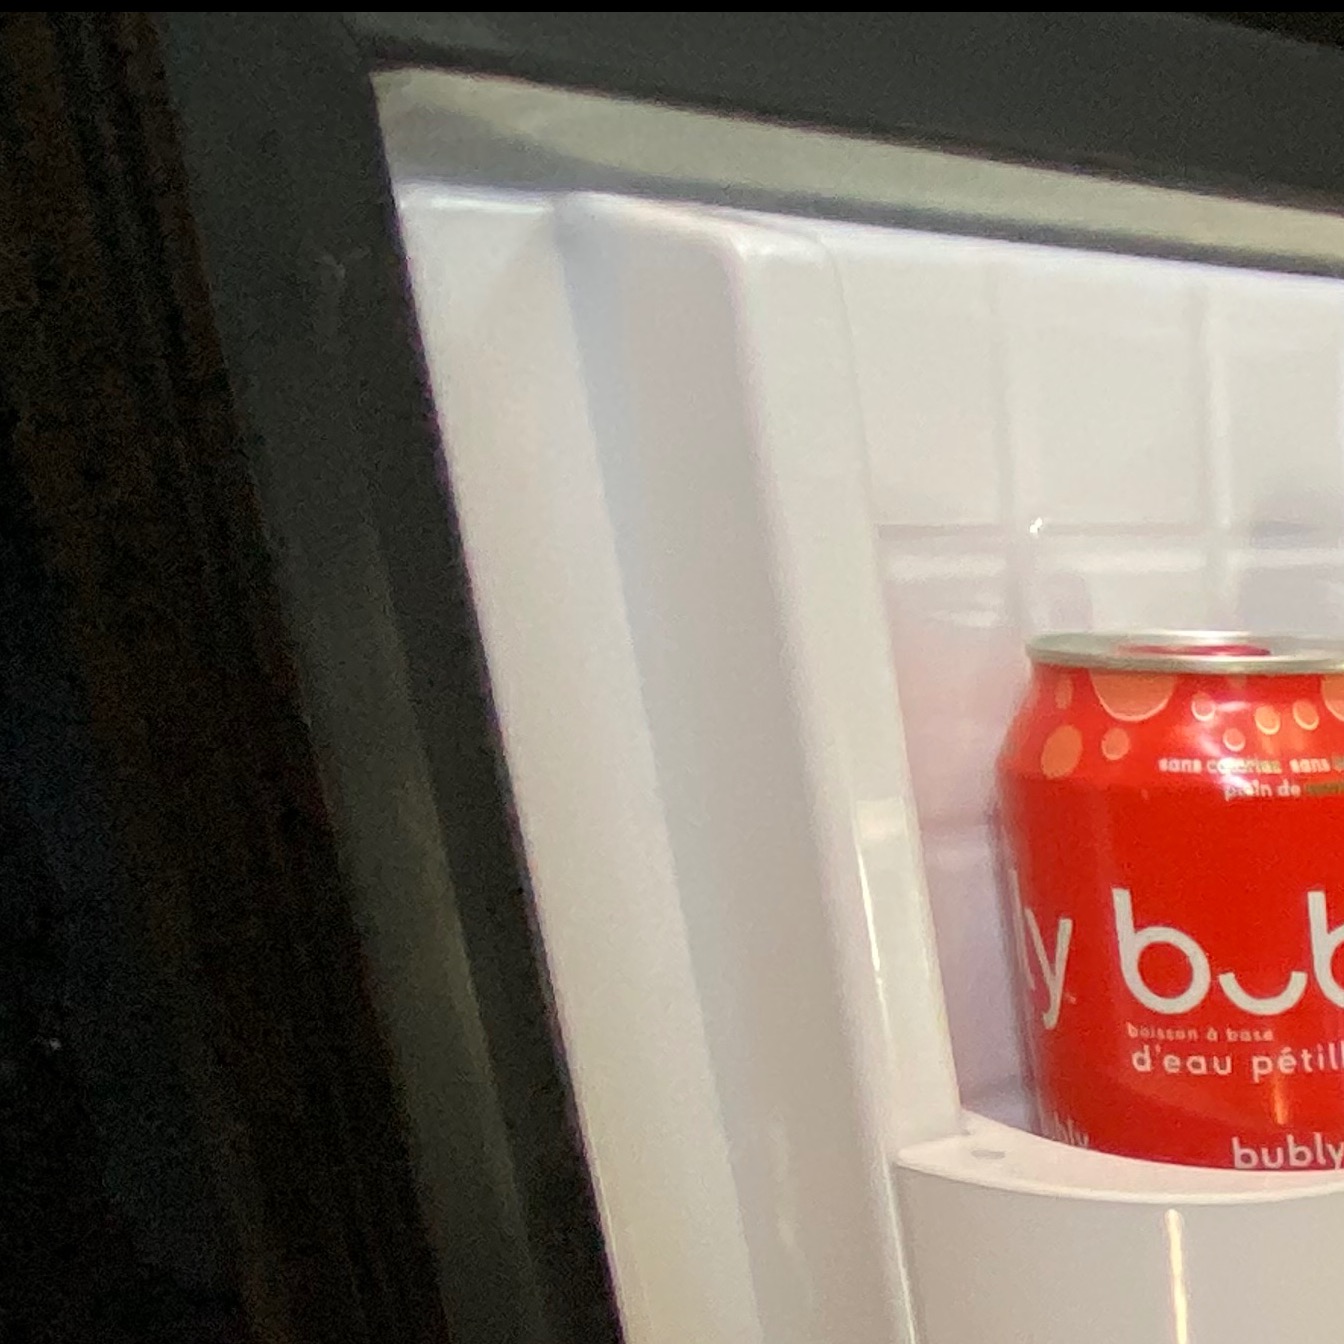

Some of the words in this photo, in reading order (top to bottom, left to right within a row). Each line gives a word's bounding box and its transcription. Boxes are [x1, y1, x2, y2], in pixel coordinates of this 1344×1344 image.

[1158, 757, 1201, 774] sans
[1289, 757, 1331, 774] sans
[1277, 779, 1301, 798] de
[1131, 1044, 1233, 1076] d'eau
